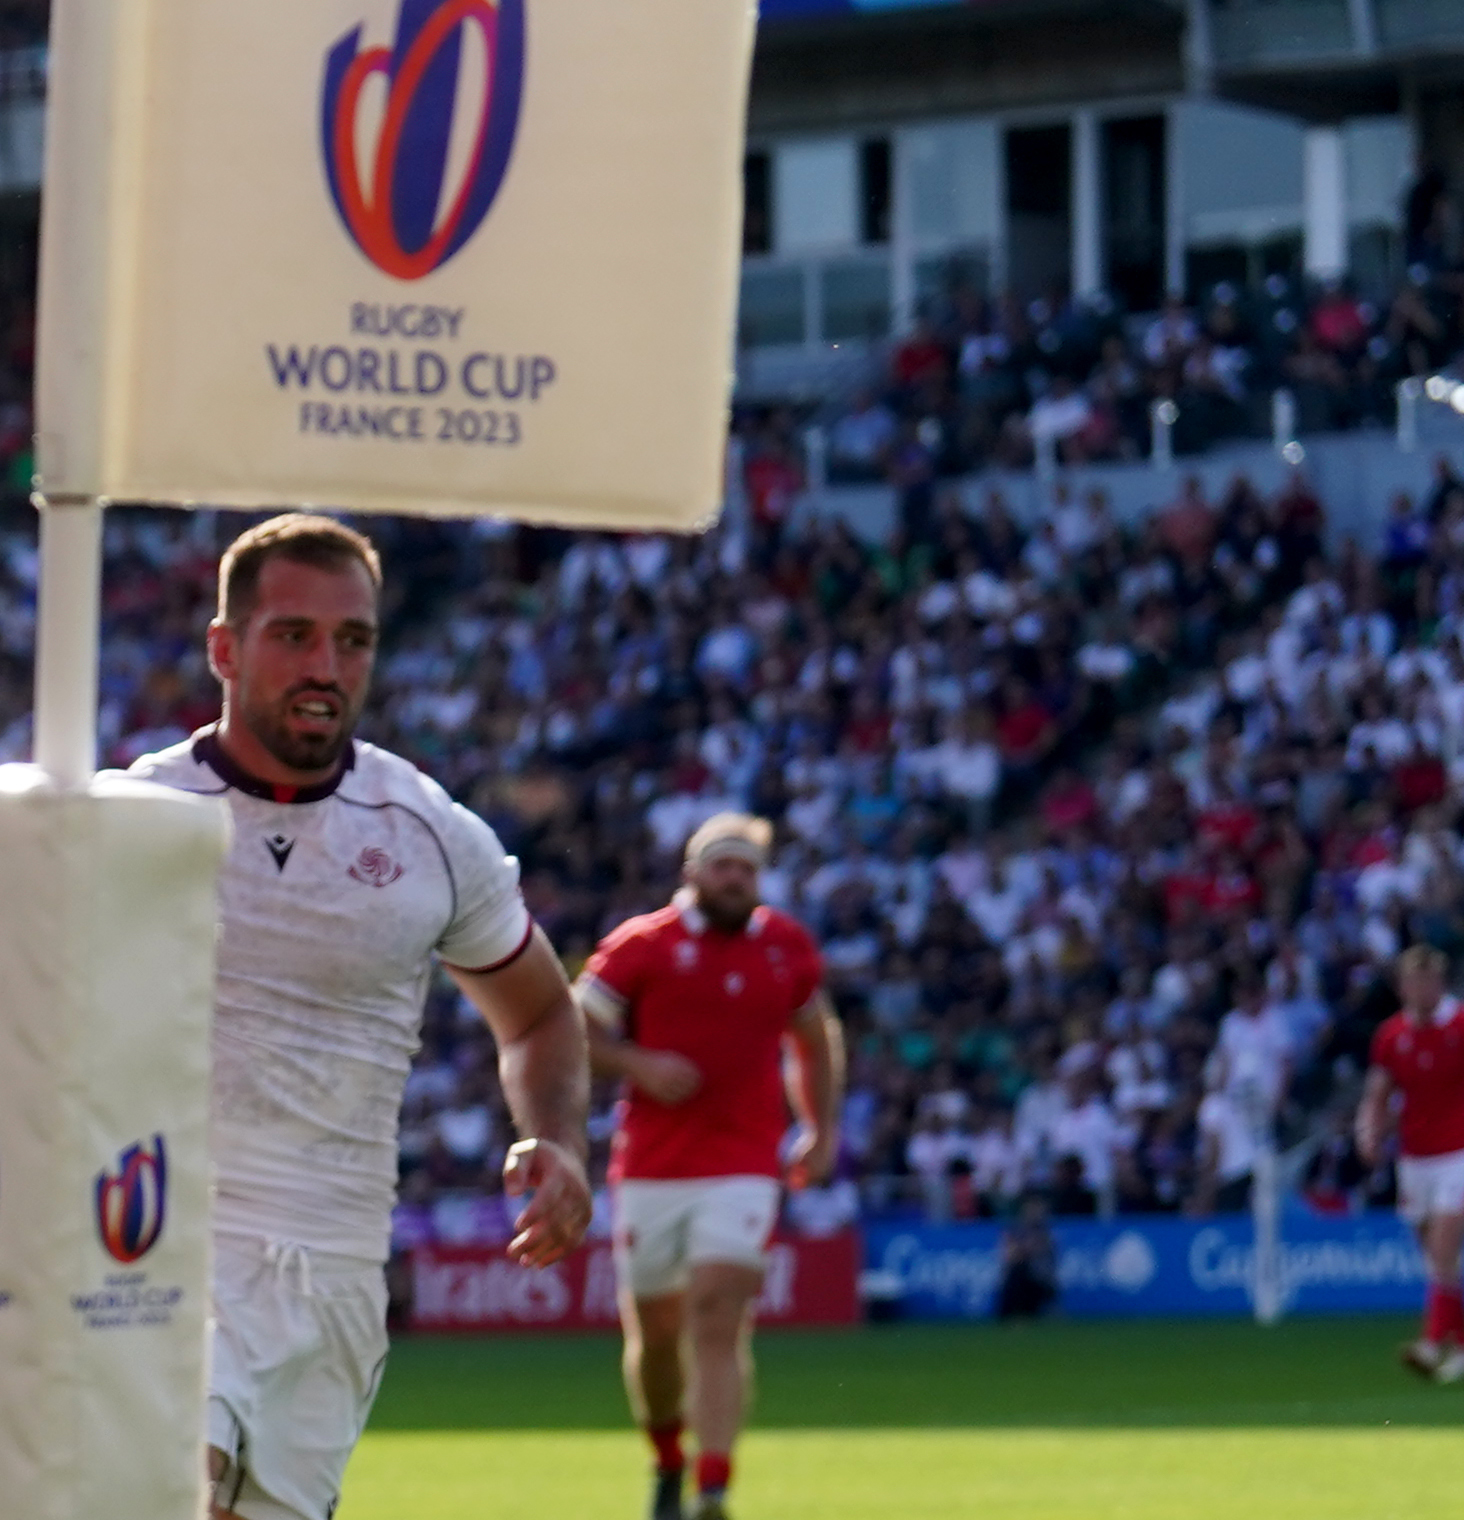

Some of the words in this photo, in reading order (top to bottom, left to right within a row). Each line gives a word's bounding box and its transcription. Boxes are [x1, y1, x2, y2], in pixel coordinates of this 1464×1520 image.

[350, 301, 465, 339] RUGBY
[266, 343, 450, 396] WORLD
[458, 351, 557, 402] CUP
[299, 402, 425, 439] FRANCE
[435, 407, 522, 445] 2023
